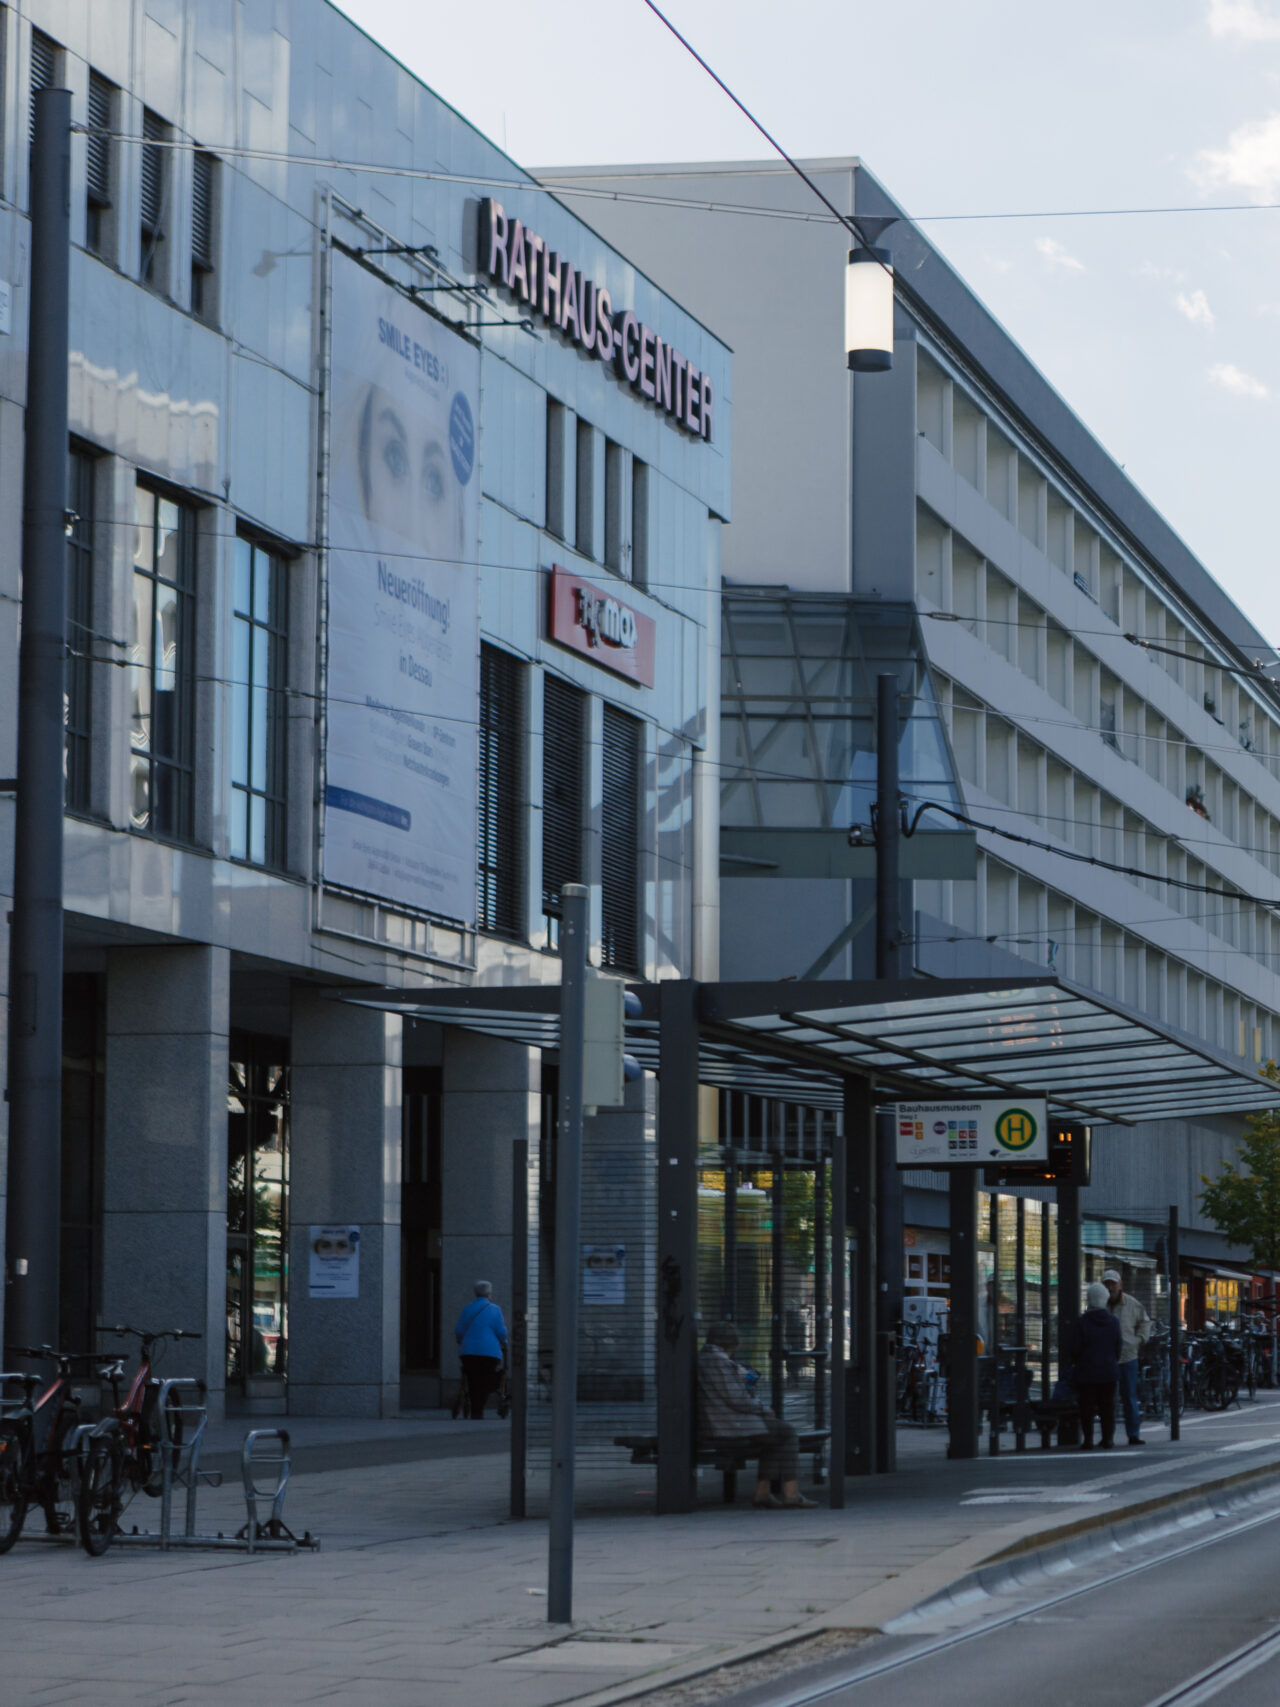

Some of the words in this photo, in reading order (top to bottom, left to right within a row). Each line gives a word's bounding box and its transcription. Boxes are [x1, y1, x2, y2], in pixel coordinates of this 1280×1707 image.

[377, 316, 411, 362] SMILE
[413, 341, 440, 382] EYES
[481, 197, 715, 442] RATHAUS-CENTER
[377, 559, 450, 634] Neueröffnung!
[899, 1103, 982, 1113] Bauhausmuseum
[1007, 1118, 1025, 1141] H
